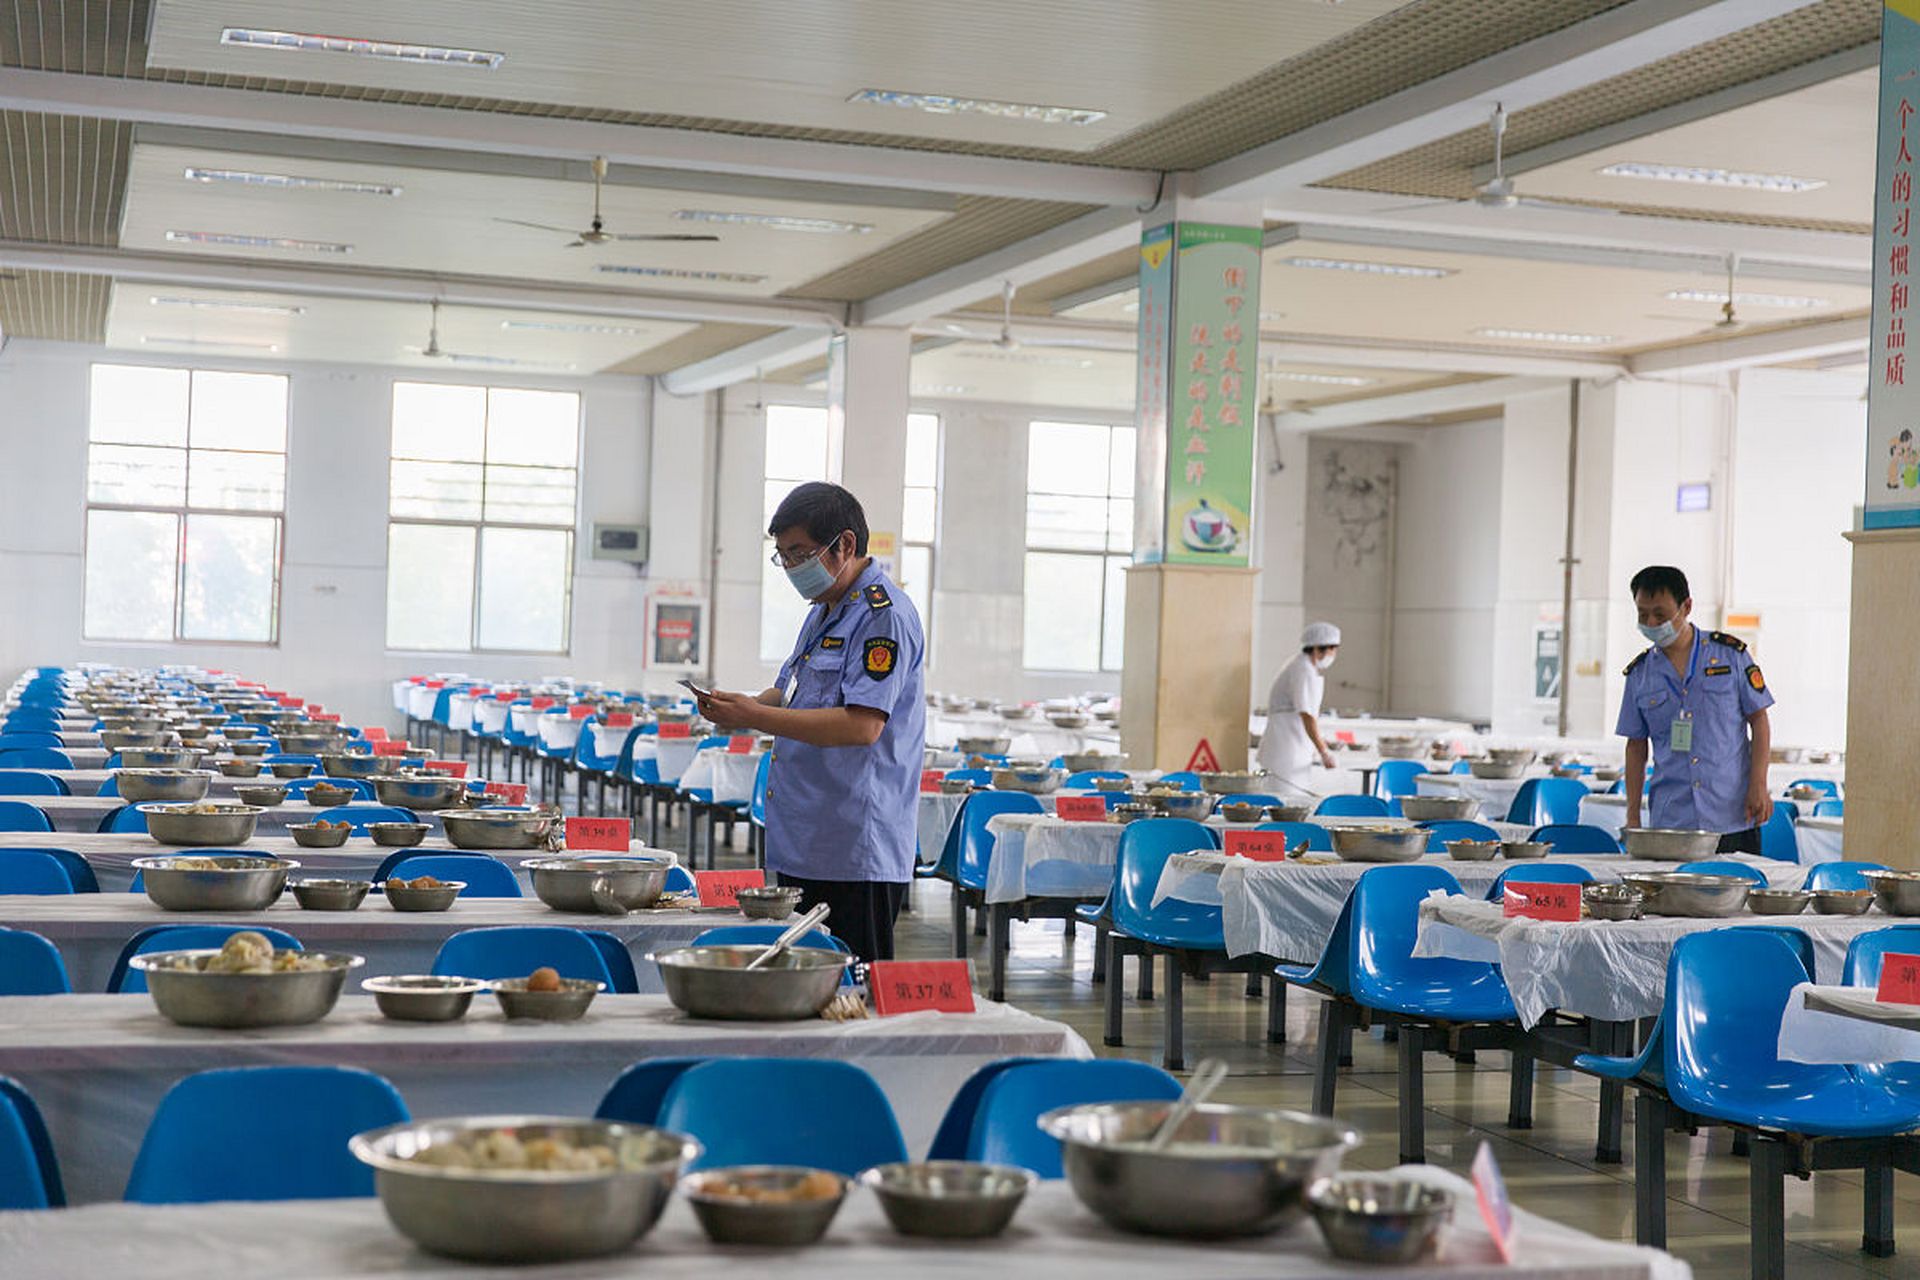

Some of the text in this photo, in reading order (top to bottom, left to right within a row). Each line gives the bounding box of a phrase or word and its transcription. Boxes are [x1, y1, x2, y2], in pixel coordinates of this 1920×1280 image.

[1885, 69, 1917, 386] 一个人的习惯和品质
[895, 981, 956, 1000] 第37桌
